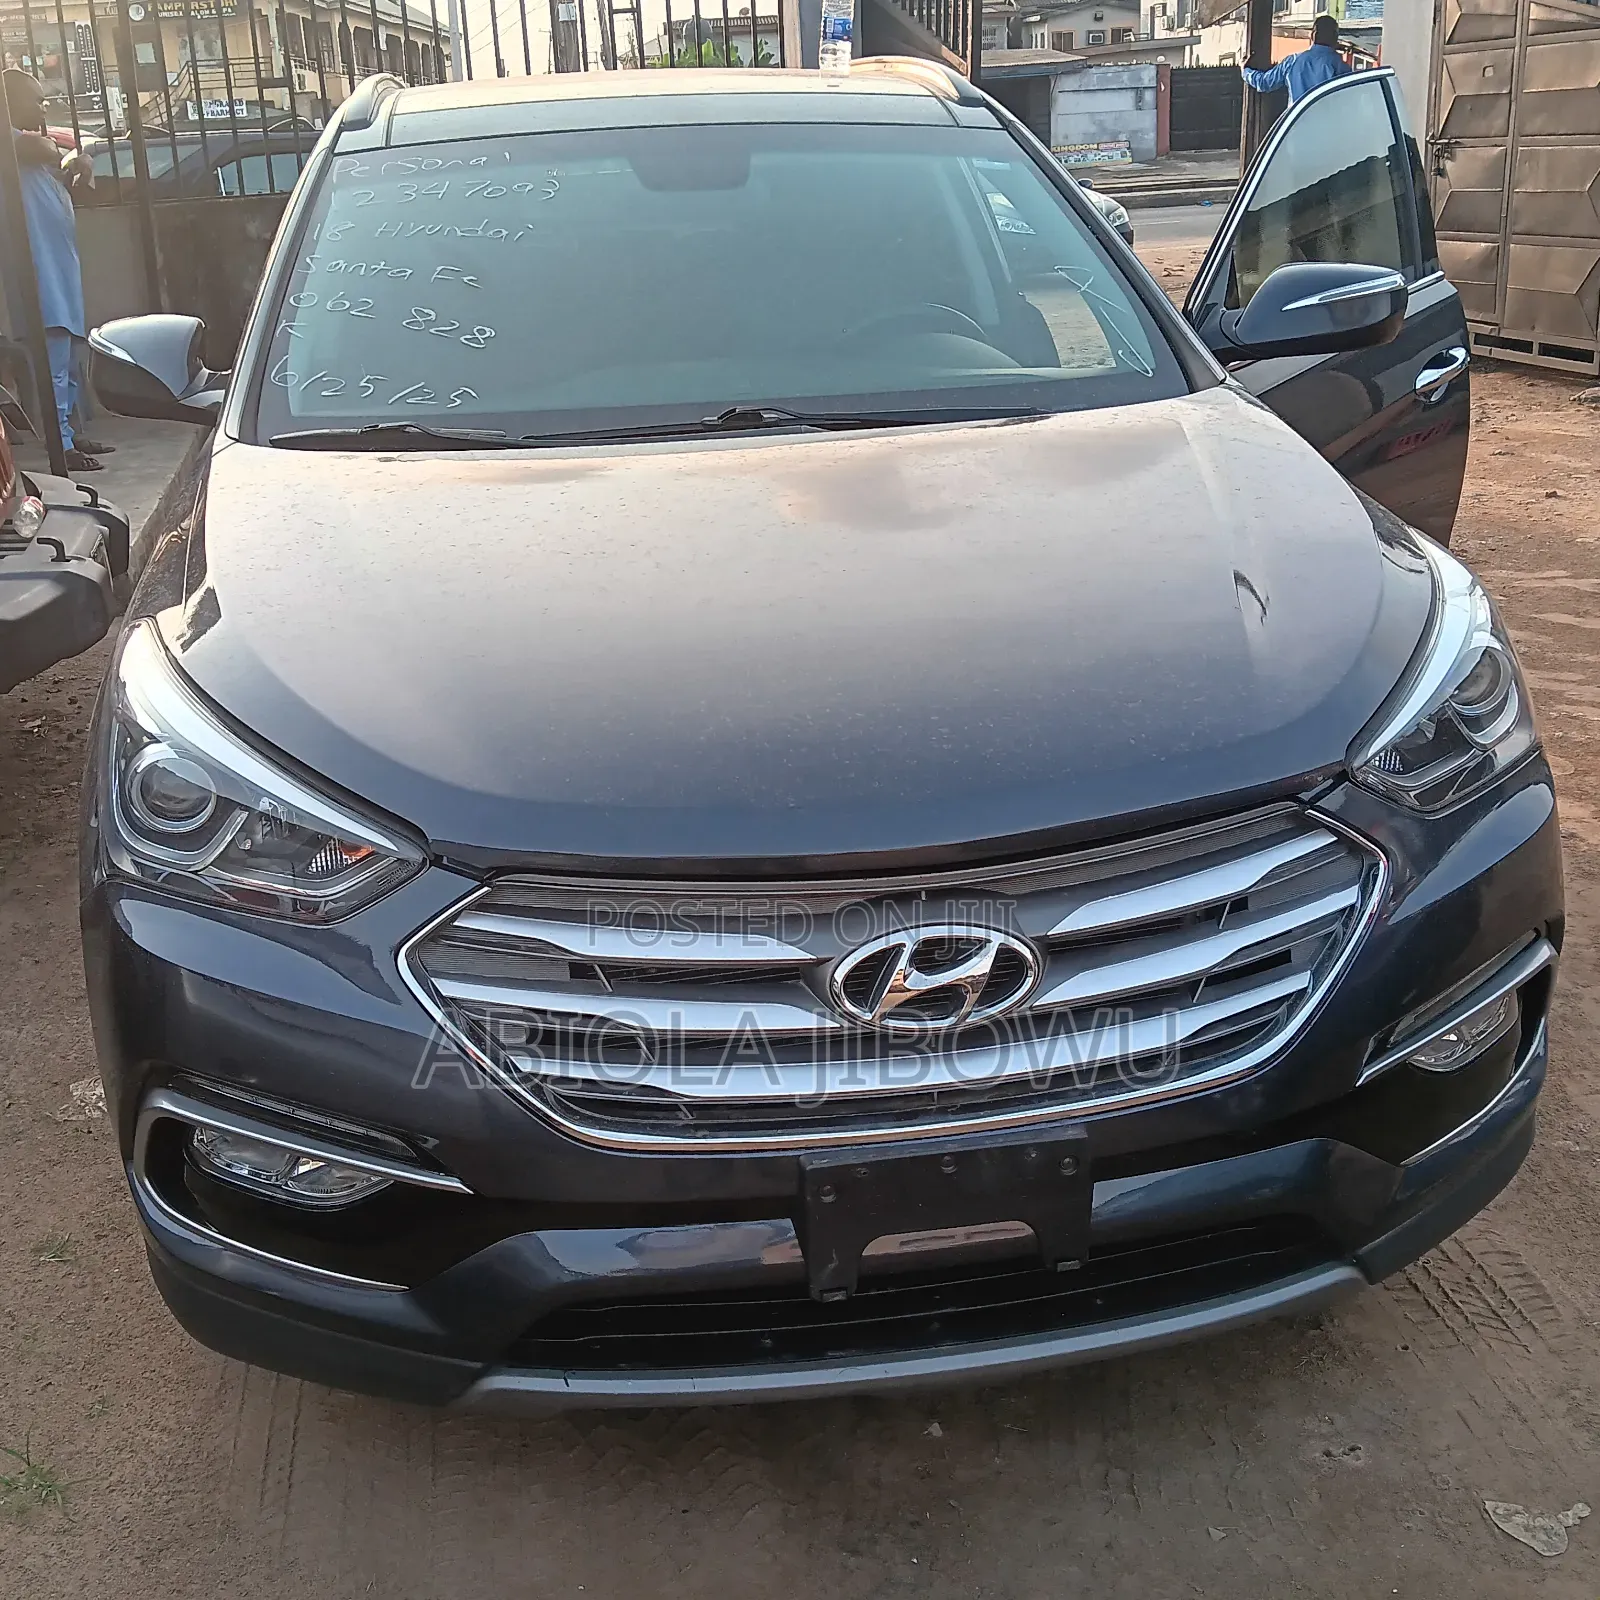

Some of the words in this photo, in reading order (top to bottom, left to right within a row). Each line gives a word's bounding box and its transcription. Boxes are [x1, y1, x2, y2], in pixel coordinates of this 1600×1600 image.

[374, 218, 534, 243] Hyundai
[298, 254, 413, 281] Santa
[402, 306, 497, 349] 828
